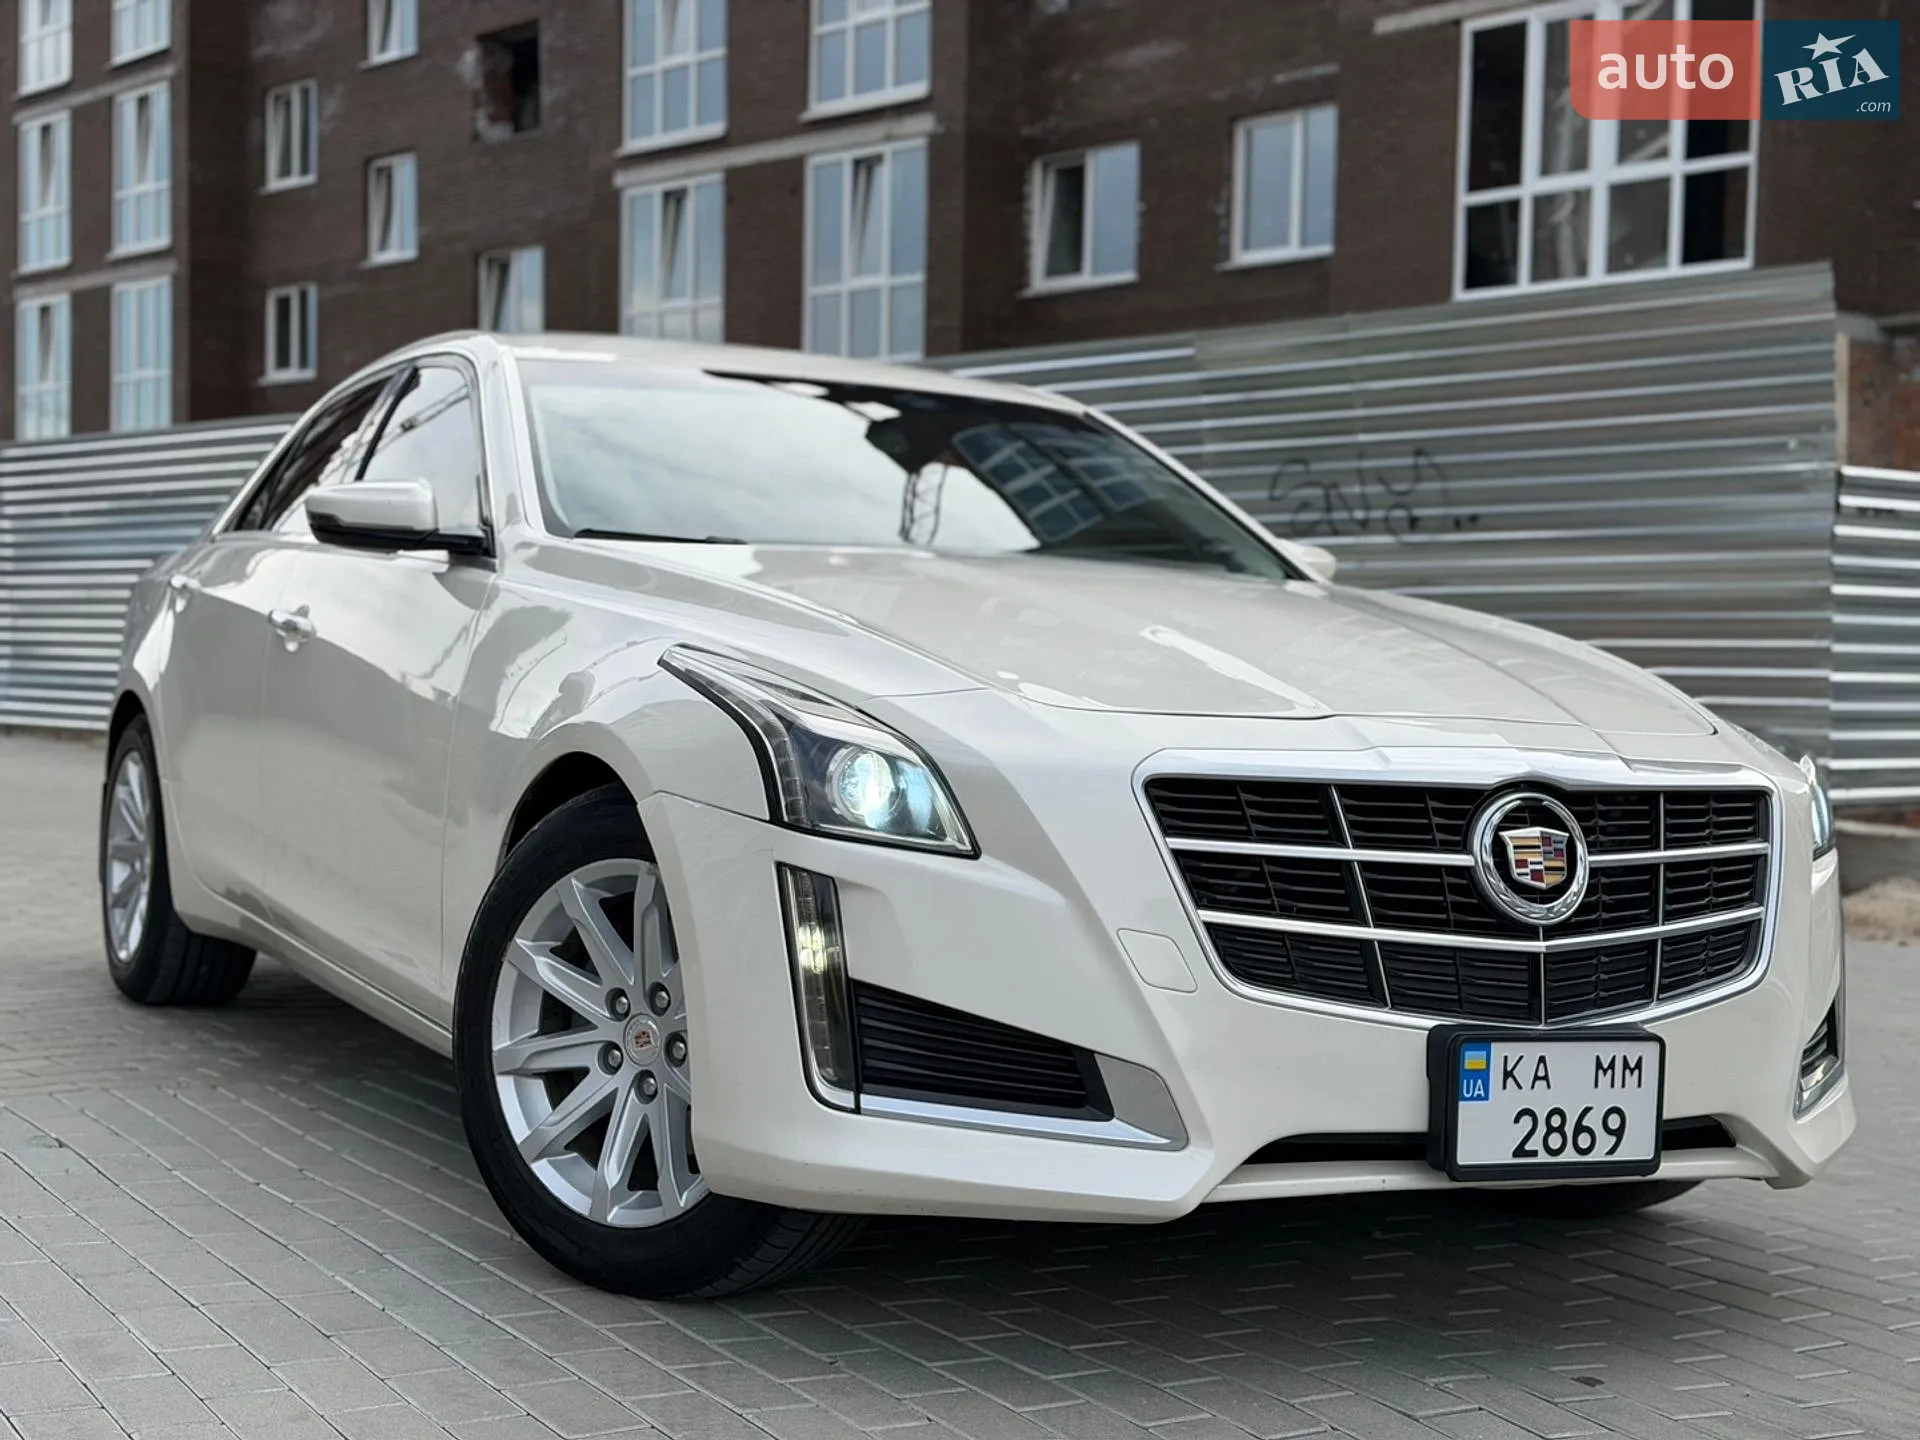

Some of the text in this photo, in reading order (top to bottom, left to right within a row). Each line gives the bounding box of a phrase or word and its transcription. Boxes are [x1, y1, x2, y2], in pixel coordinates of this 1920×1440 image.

[1463, 1079, 1485, 1098] UA
[1502, 1054, 1643, 1090] KA MM
[1512, 1105, 1627, 1158] 2869
